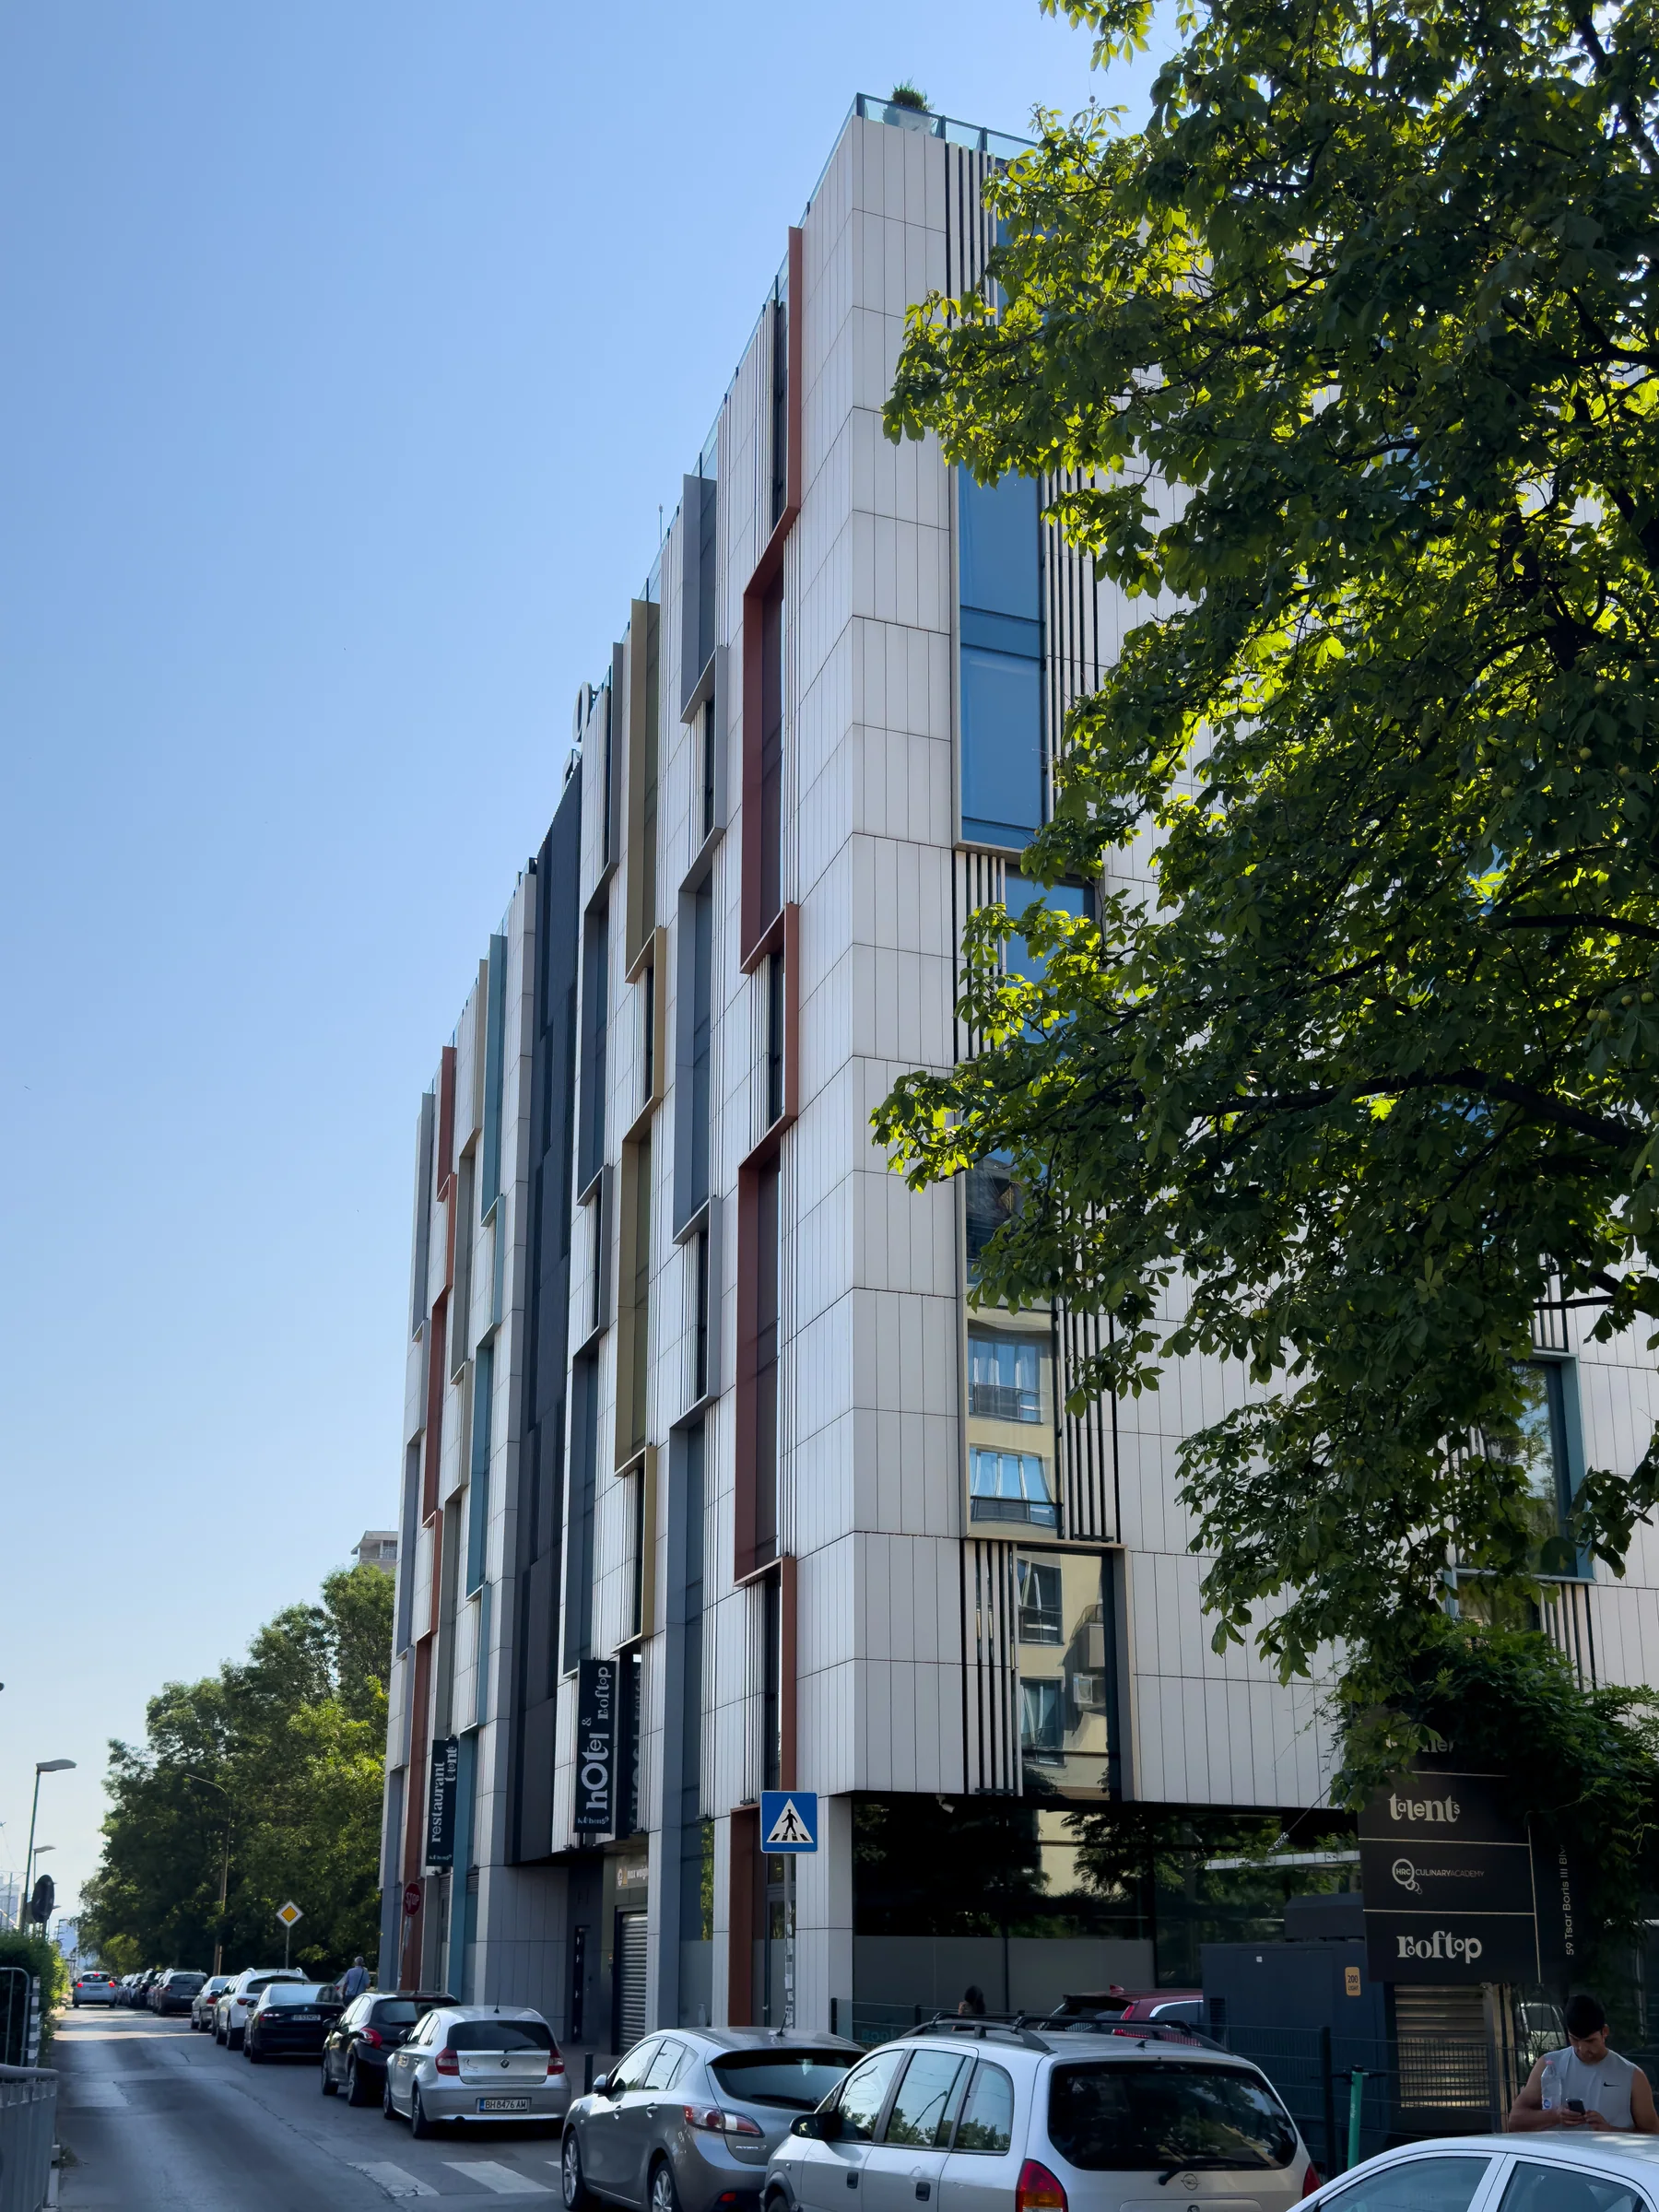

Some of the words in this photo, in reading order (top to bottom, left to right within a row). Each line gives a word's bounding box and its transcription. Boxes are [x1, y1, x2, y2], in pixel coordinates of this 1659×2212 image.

[582, 1716, 593, 1726] &
[594, 1666, 612, 1720] rooftop
[431, 1761, 445, 1843] restaurant
[1387, 1793, 1461, 1823] talents
[1395, 1867, 1412, 1876] HRC
[406, 1892, 420, 1911] STOP
[1561, 1881, 1571, 1911] Boris
[1565, 1913, 1573, 1940] Tsar
[1396, 1930, 1482, 1964] rooftop
[1566, 1942, 1574, 1956] 59
